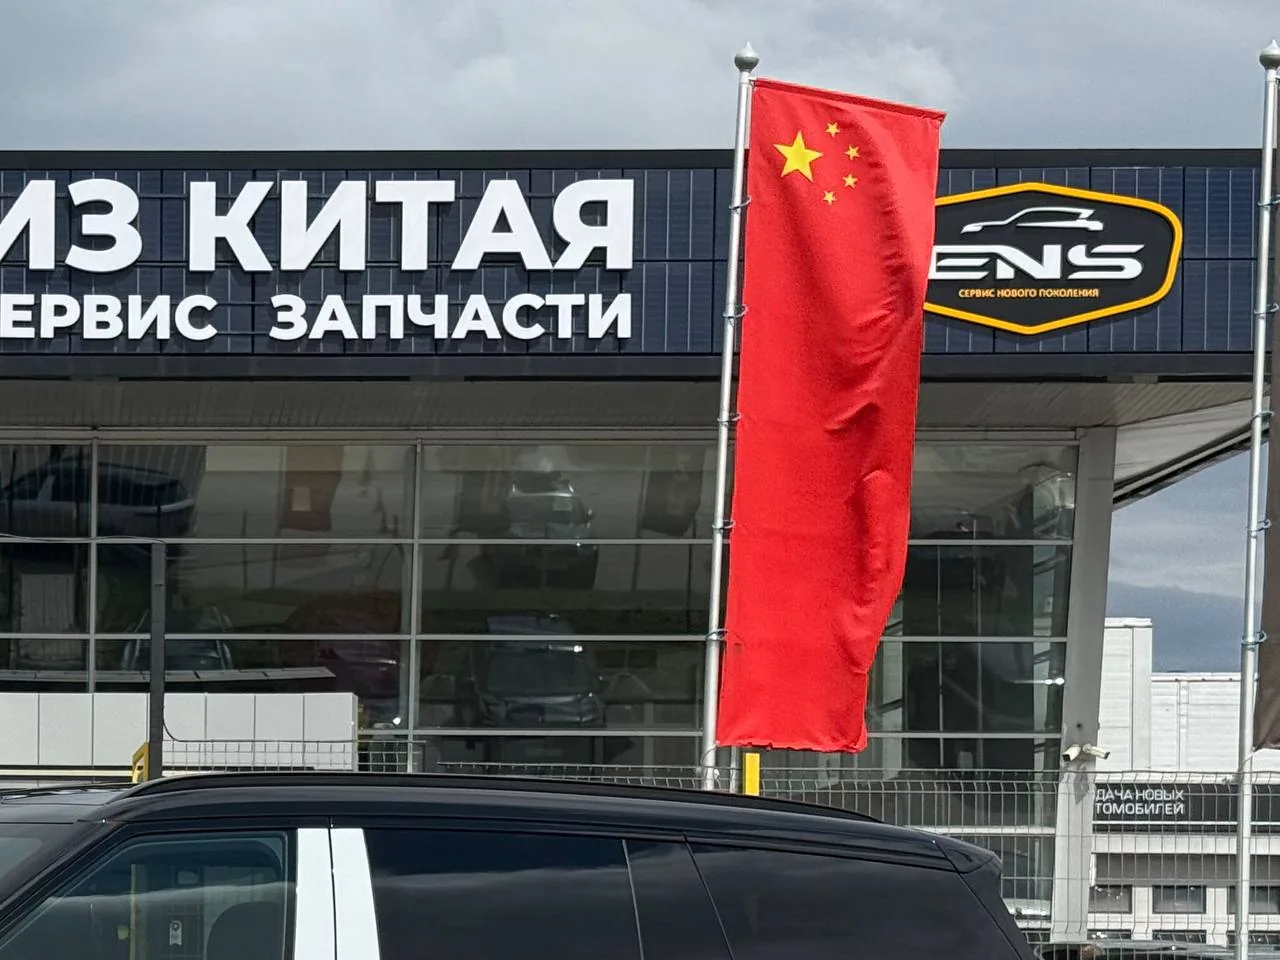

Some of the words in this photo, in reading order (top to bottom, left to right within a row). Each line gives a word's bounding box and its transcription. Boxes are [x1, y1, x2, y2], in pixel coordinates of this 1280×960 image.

[189, 178, 635, 272] КИТАЯ
[928, 244, 1145, 280] ENS
[958, 288, 996, 298] СЕРВИС
[997, 288, 1037, 298] НОВОГО
[1039, 288, 1099, 298] ПОКОЛЕНИЯ
[269, 292, 632, 341] ЗАПЧАСТИ
[1136, 788, 1184, 801] НОВЫХ
[1095, 801, 1184, 815] ТОМОБИЛЕЙ
